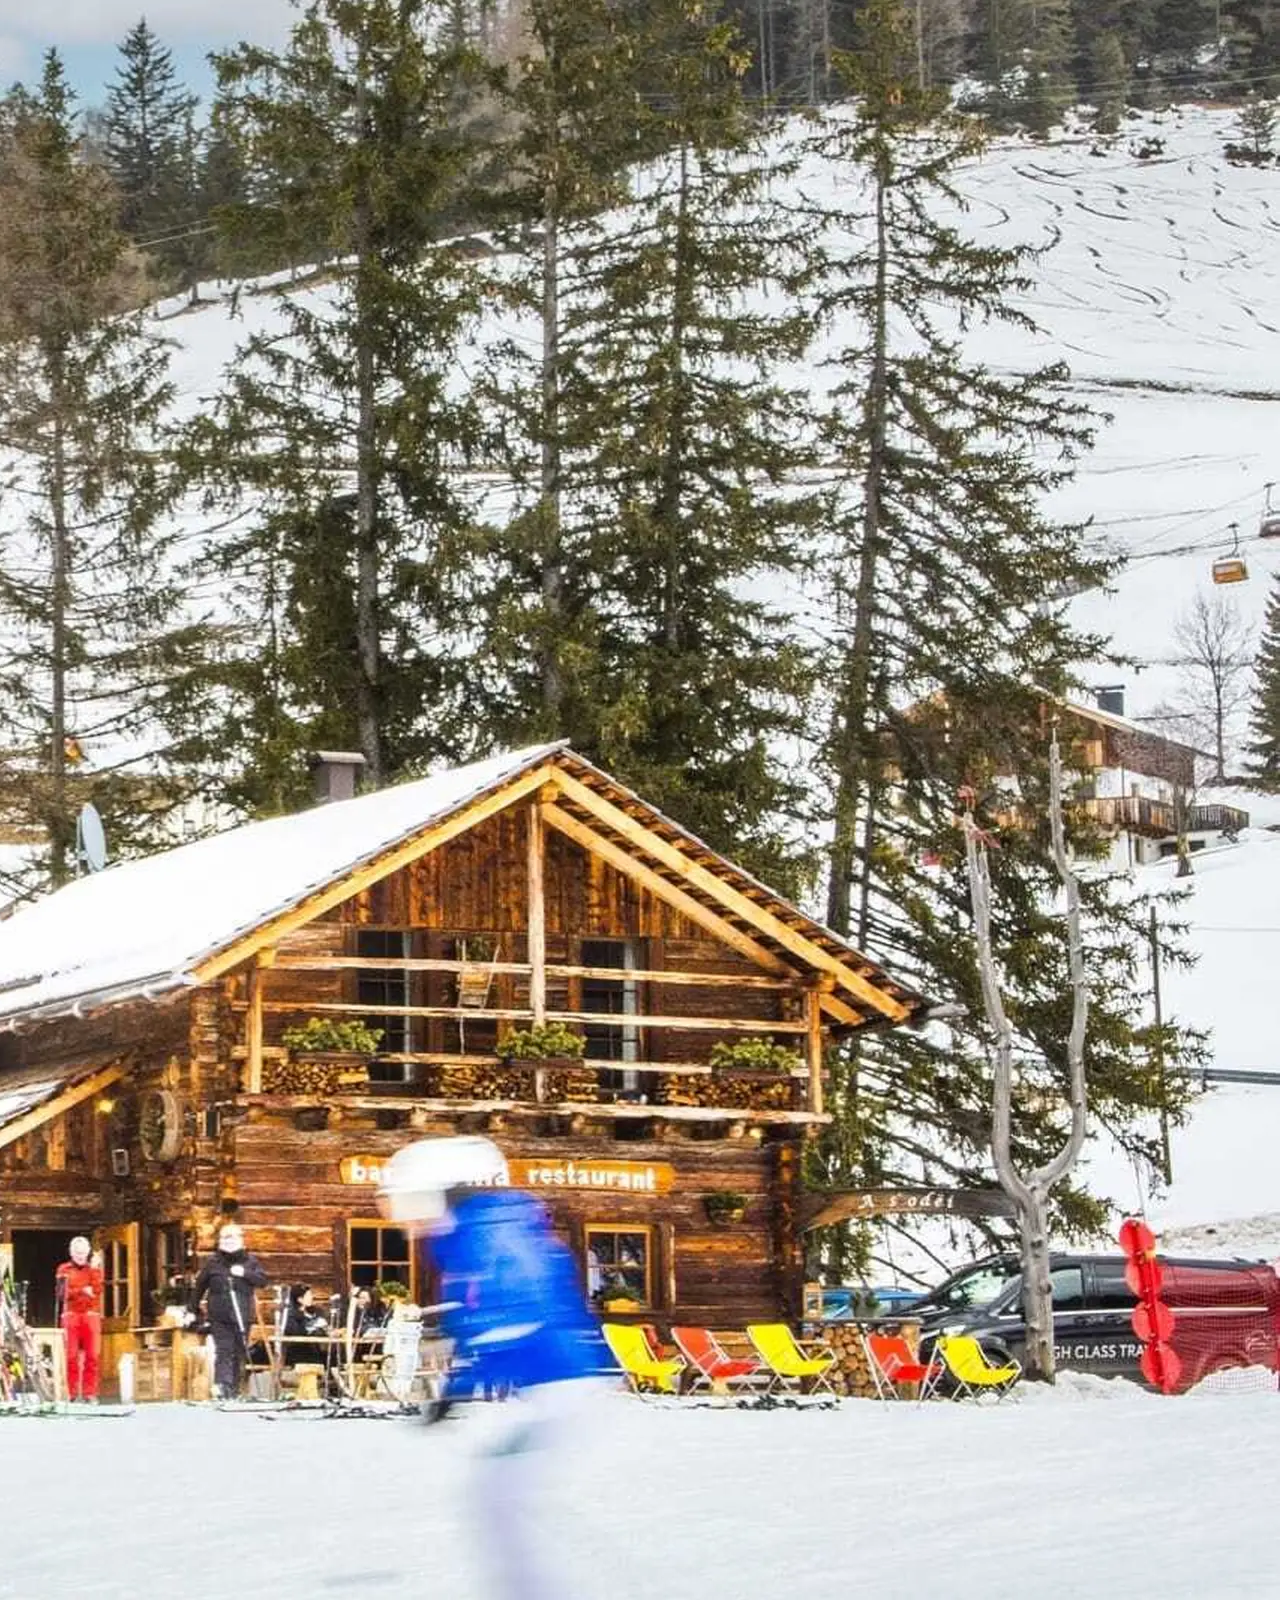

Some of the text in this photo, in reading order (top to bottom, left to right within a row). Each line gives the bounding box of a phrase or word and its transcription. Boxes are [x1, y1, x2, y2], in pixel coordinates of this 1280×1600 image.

[528, 1161, 657, 1190] restaurant
[1052, 1343, 1147, 1360] GH CLASS TRA
